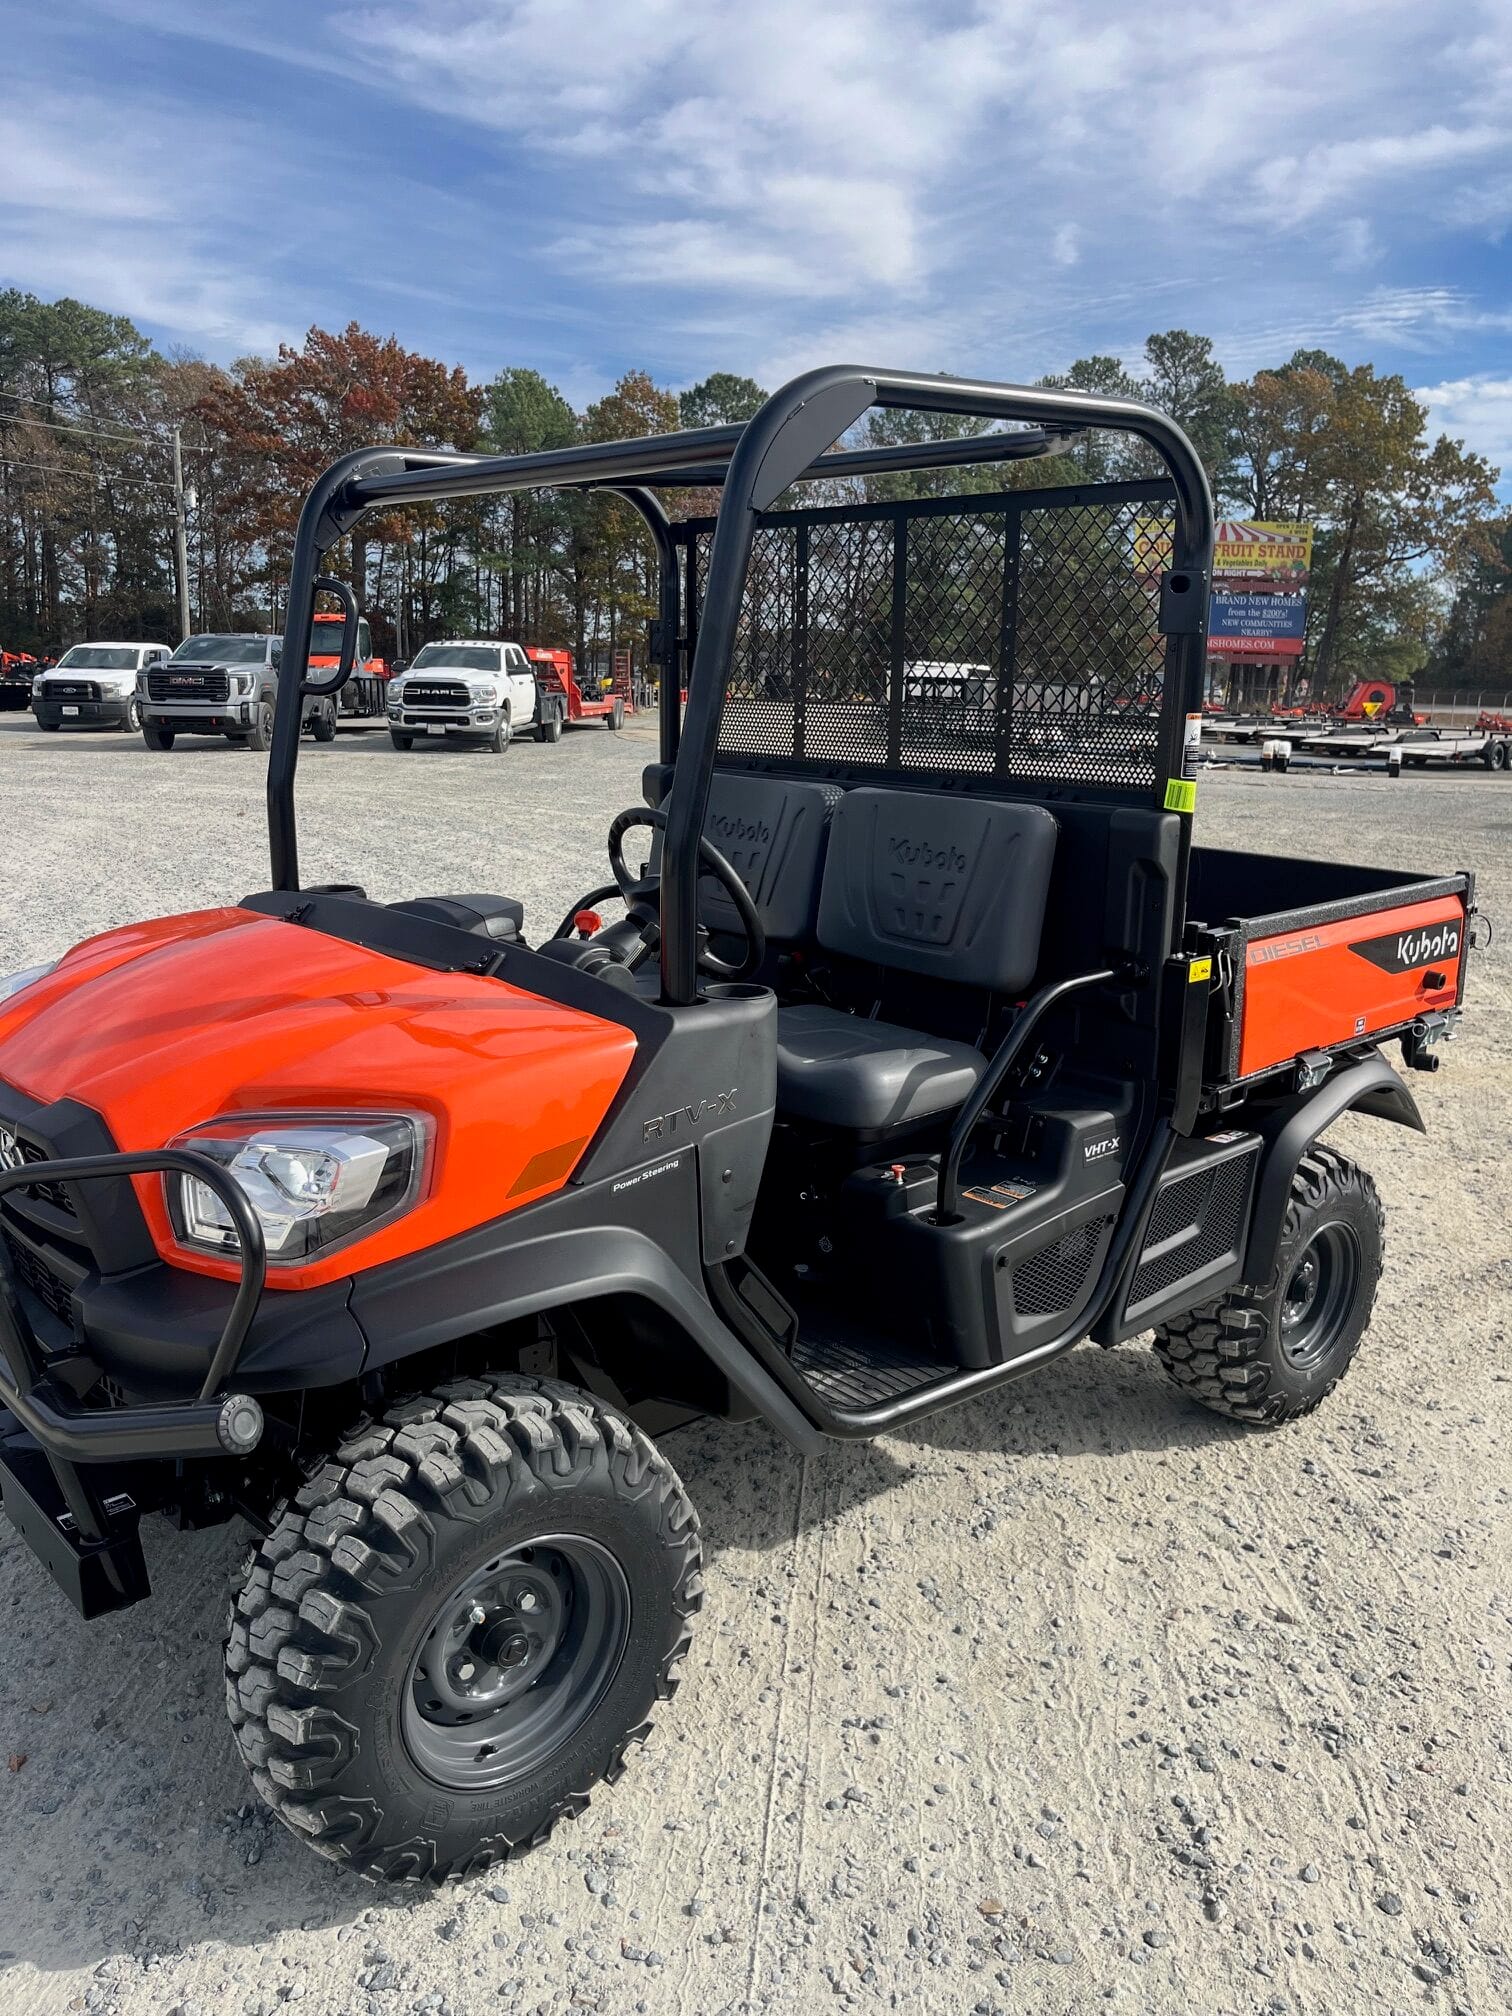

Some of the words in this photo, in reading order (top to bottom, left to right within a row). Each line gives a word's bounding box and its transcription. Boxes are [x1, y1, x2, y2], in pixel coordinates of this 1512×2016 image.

[1258, 544, 1307, 558] STAND
[1222, 559, 1253, 568] Vegetables
[1254, 559, 1267, 567] Daily
[1212, 569, 1223, 577] ON
[1224, 569, 1247, 577] RIGHT
[1215, 596, 1247, 605] BRAND
[1248, 596, 1269, 606] NEW
[1271, 597, 1303, 607] HOMES
[1228, 607, 1246, 617] from
[1248, 608, 1261, 617] the
[1221, 619, 1239, 627] NEW
[1240, 619, 1293, 628] COMMUNITIES
[169, 676, 204, 686] GMC
[710, 813, 770, 844] Kubota
[889, 835, 966, 874] Kubota
[1250, 935, 1329, 965] DIESEL
[1396, 925, 1459, 966] Kubota
[643, 1088, 738, 1144] RTV-X
[1084, 1136, 1121, 1158] VHT-X
[613, 1176, 641, 1193] Power
[642, 1159, 679, 1181] Steering
[494, 1783, 540, 1808] WORKSITE
[470, 1800, 492, 1812] TIRE
